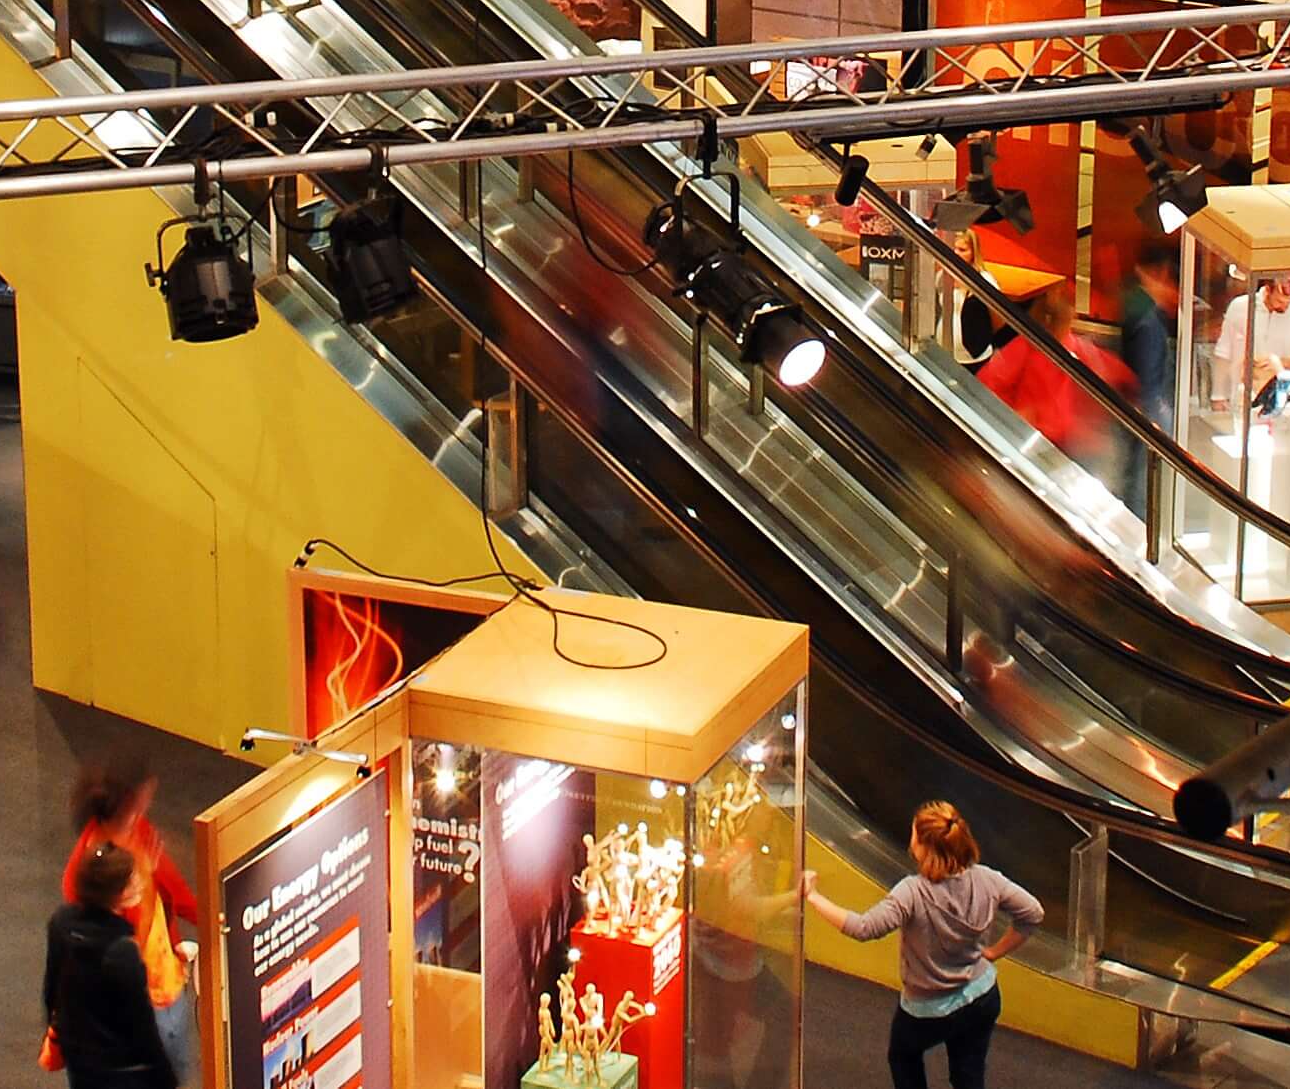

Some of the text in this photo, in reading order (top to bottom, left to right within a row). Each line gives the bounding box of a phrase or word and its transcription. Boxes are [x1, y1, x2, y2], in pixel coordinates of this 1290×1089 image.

[427, 835, 453, 854] fuel
[243, 827, 370, 930] Our Energy Options
